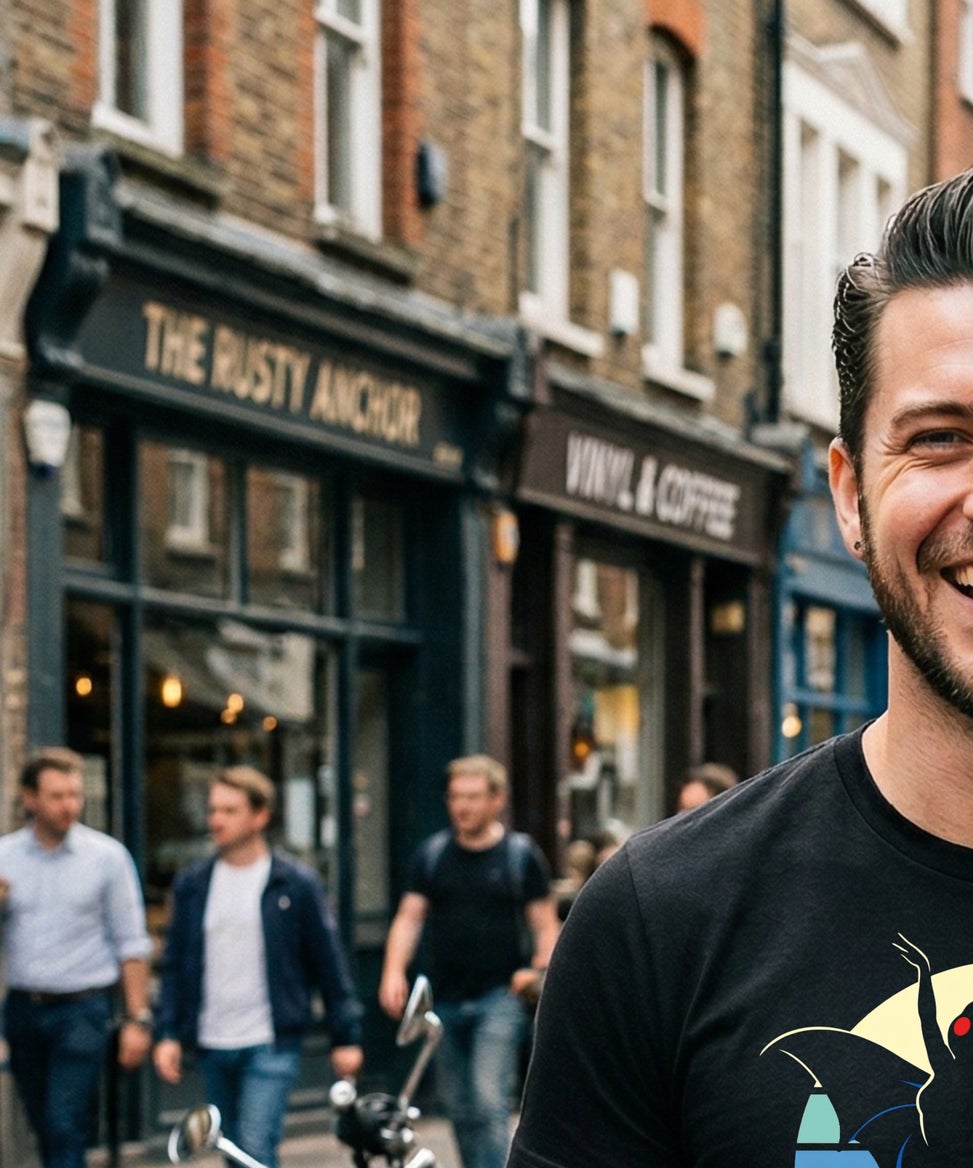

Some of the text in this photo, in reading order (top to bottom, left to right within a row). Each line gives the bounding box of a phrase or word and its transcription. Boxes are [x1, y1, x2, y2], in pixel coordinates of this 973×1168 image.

[143, 300, 422, 448] THE RUSTY ANCHOR
[566, 431, 741, 541] VINYL & COFFEE
